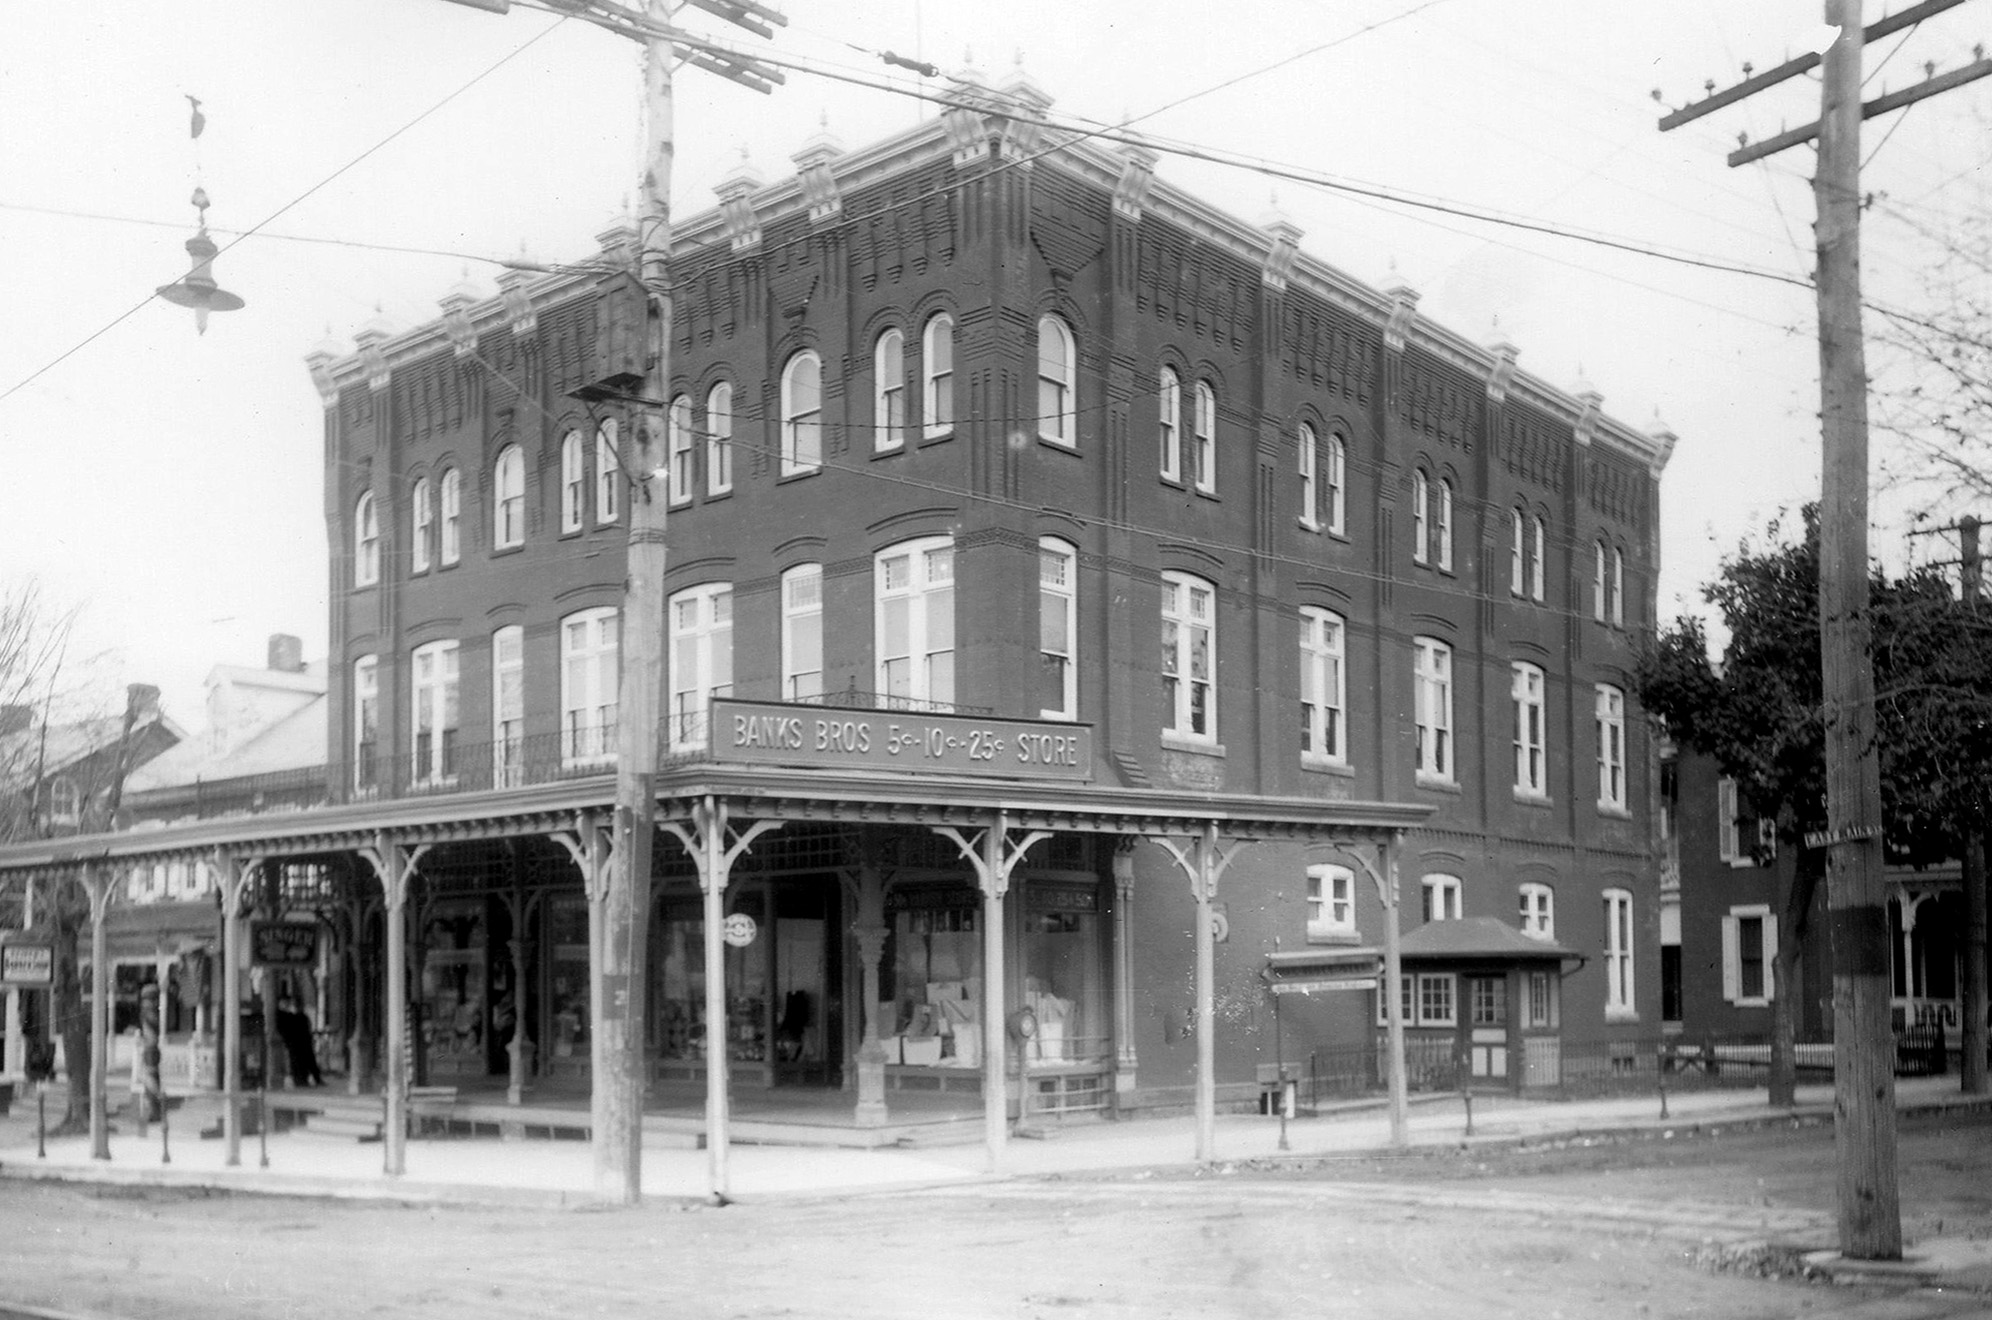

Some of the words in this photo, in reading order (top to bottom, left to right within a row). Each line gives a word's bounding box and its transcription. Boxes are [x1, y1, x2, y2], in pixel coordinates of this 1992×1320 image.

[734, 714, 802, 750] BANKS
[815, 719, 871, 753] BROS
[1017, 733, 1078, 767] STORE
